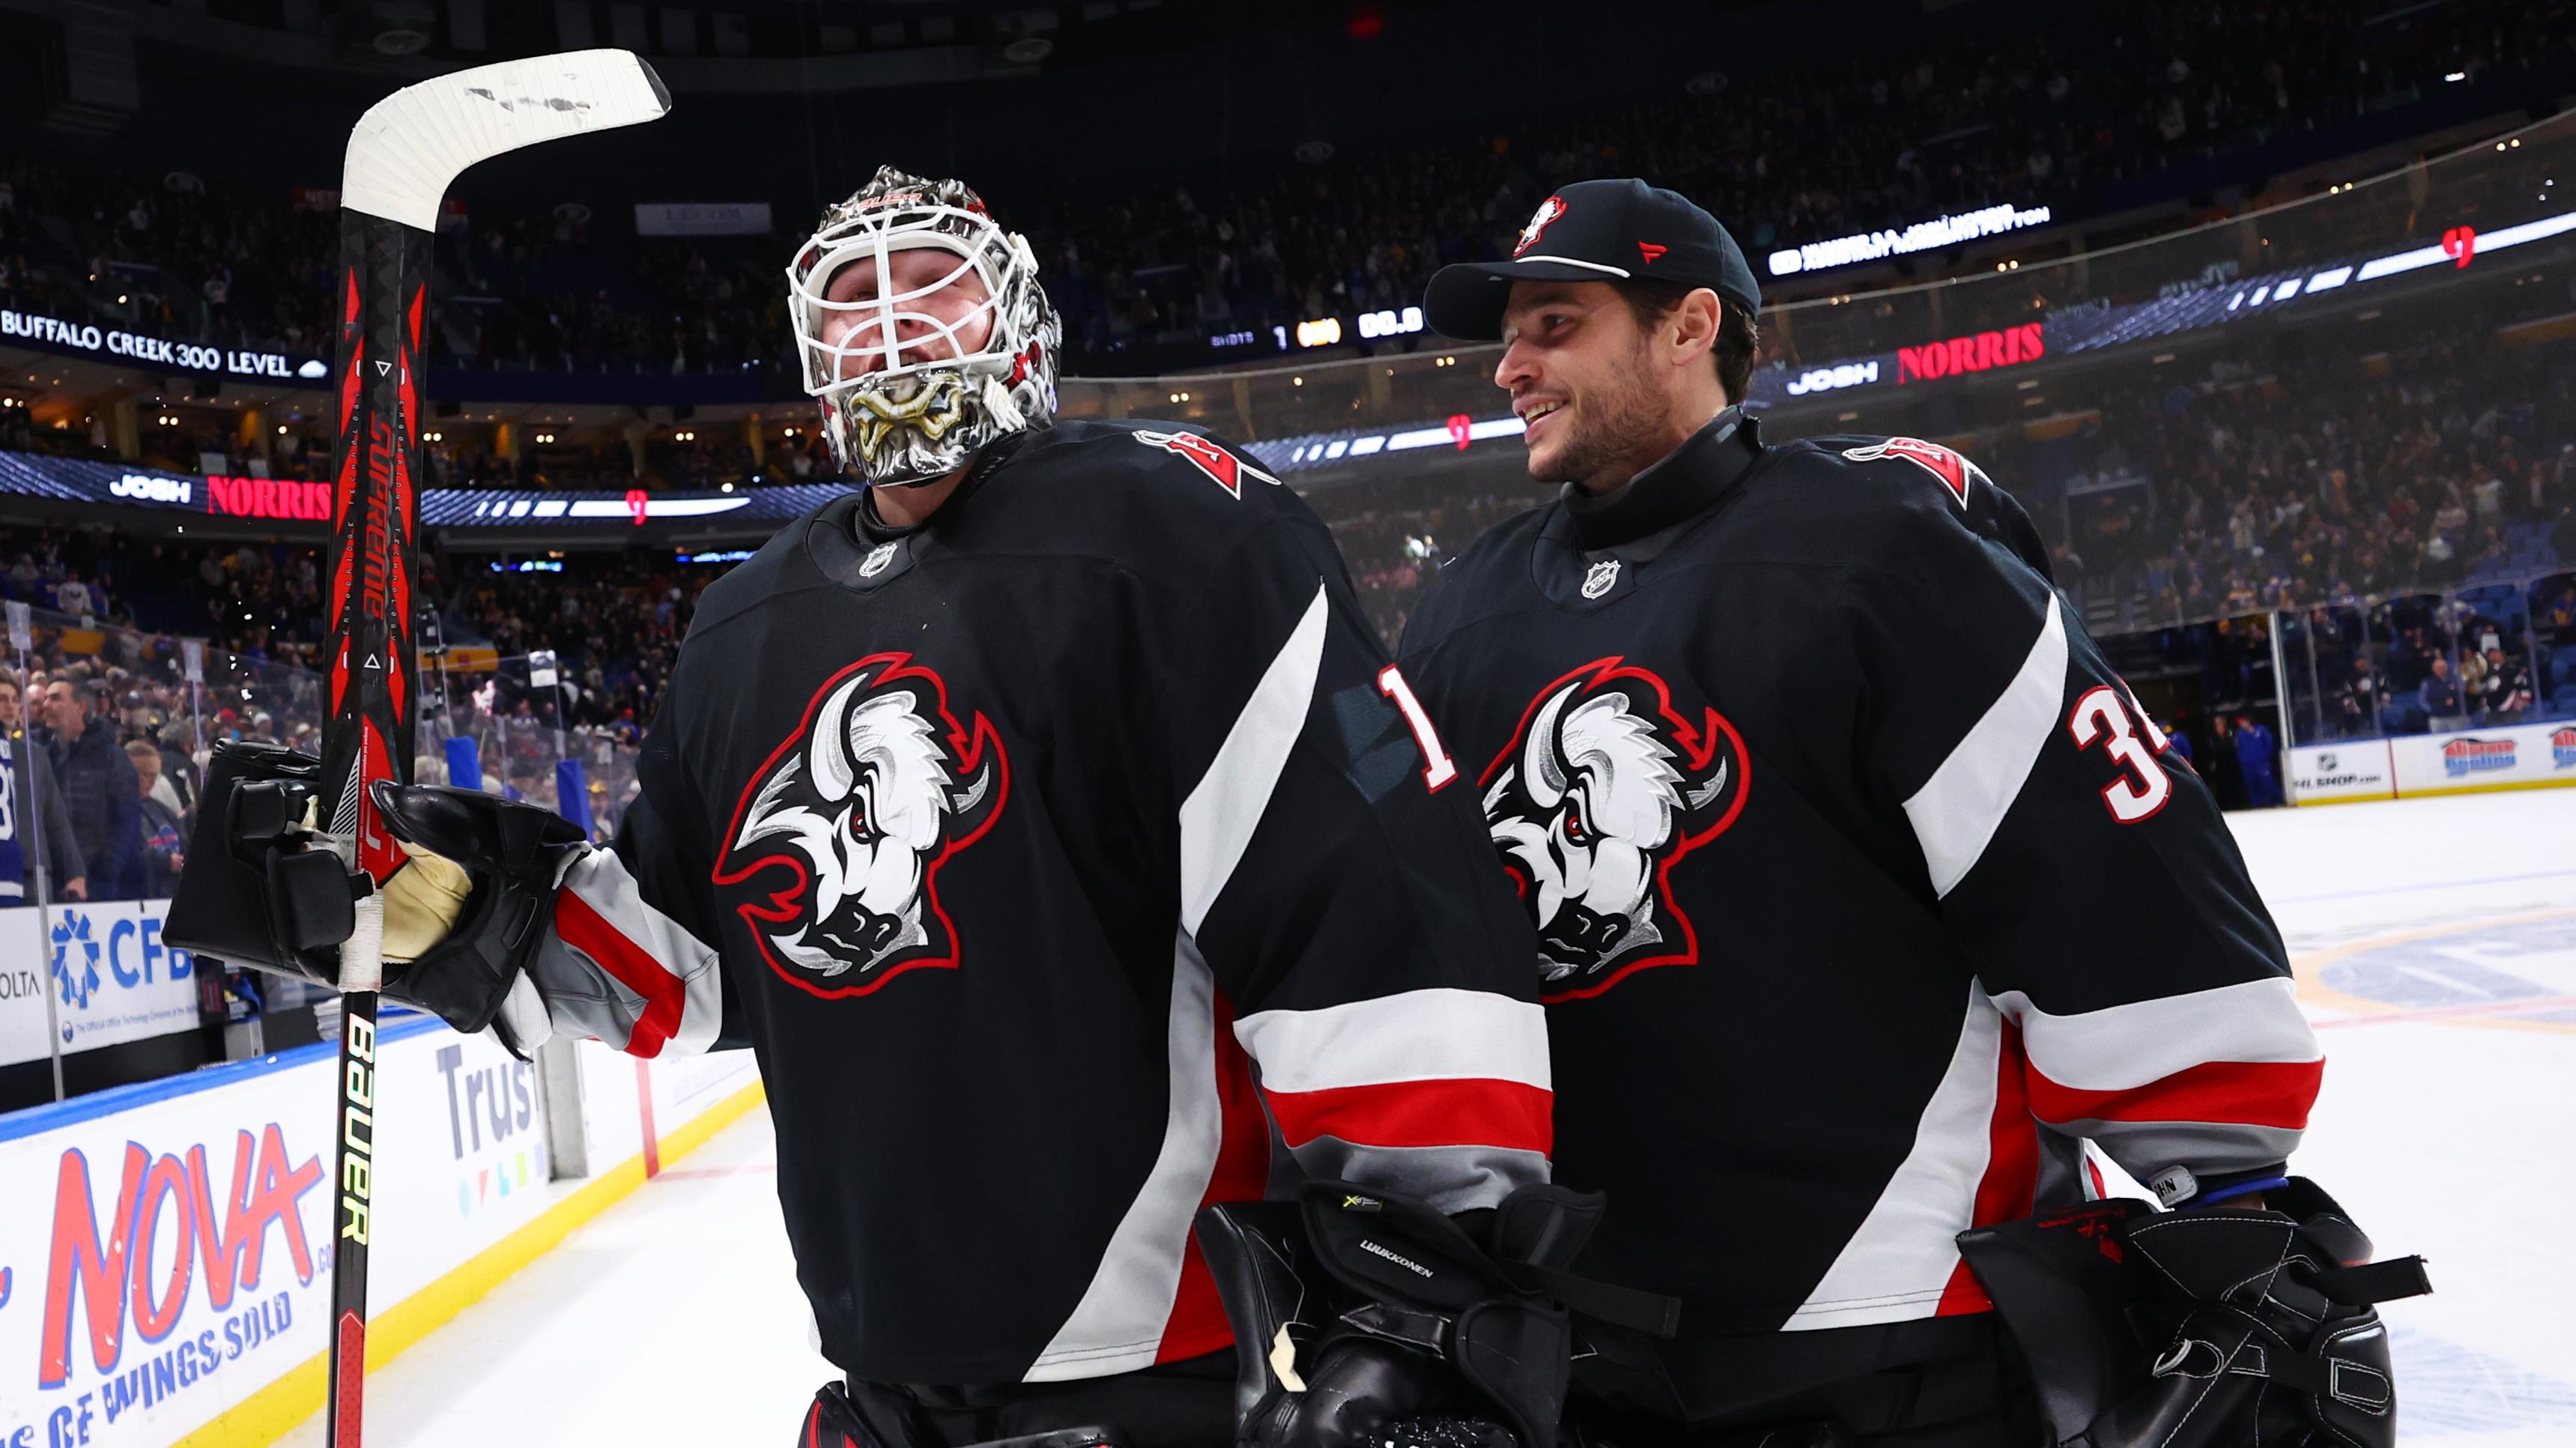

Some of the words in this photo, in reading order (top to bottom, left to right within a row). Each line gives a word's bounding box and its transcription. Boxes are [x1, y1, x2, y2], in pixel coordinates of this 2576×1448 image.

[1, 309, 102, 351] BUFFALO
[106, 330, 175, 364] CREEK
[176, 344, 221, 371] 300
[228, 351, 293, 378] LEVEL
[1786, 360, 1879, 396] JOSH
[1897, 321, 2045, 385] NORRIS
[109, 474, 191, 503] JOSH
[207, 475, 333, 521] NORRIS
[363, 410, 392, 620] SUPREME
[1378, 662, 1458, 795] 1
[2067, 674, 2171, 824] 3
[38, 1122, 325, 1390] NOVA
[1360, 1240, 1434, 1278] LUUKKONEN
[48, 1393, 94, 1448] OF
[102, 1330, 222, 1424] WINGS
[224, 1291, 293, 1360] SOLD
